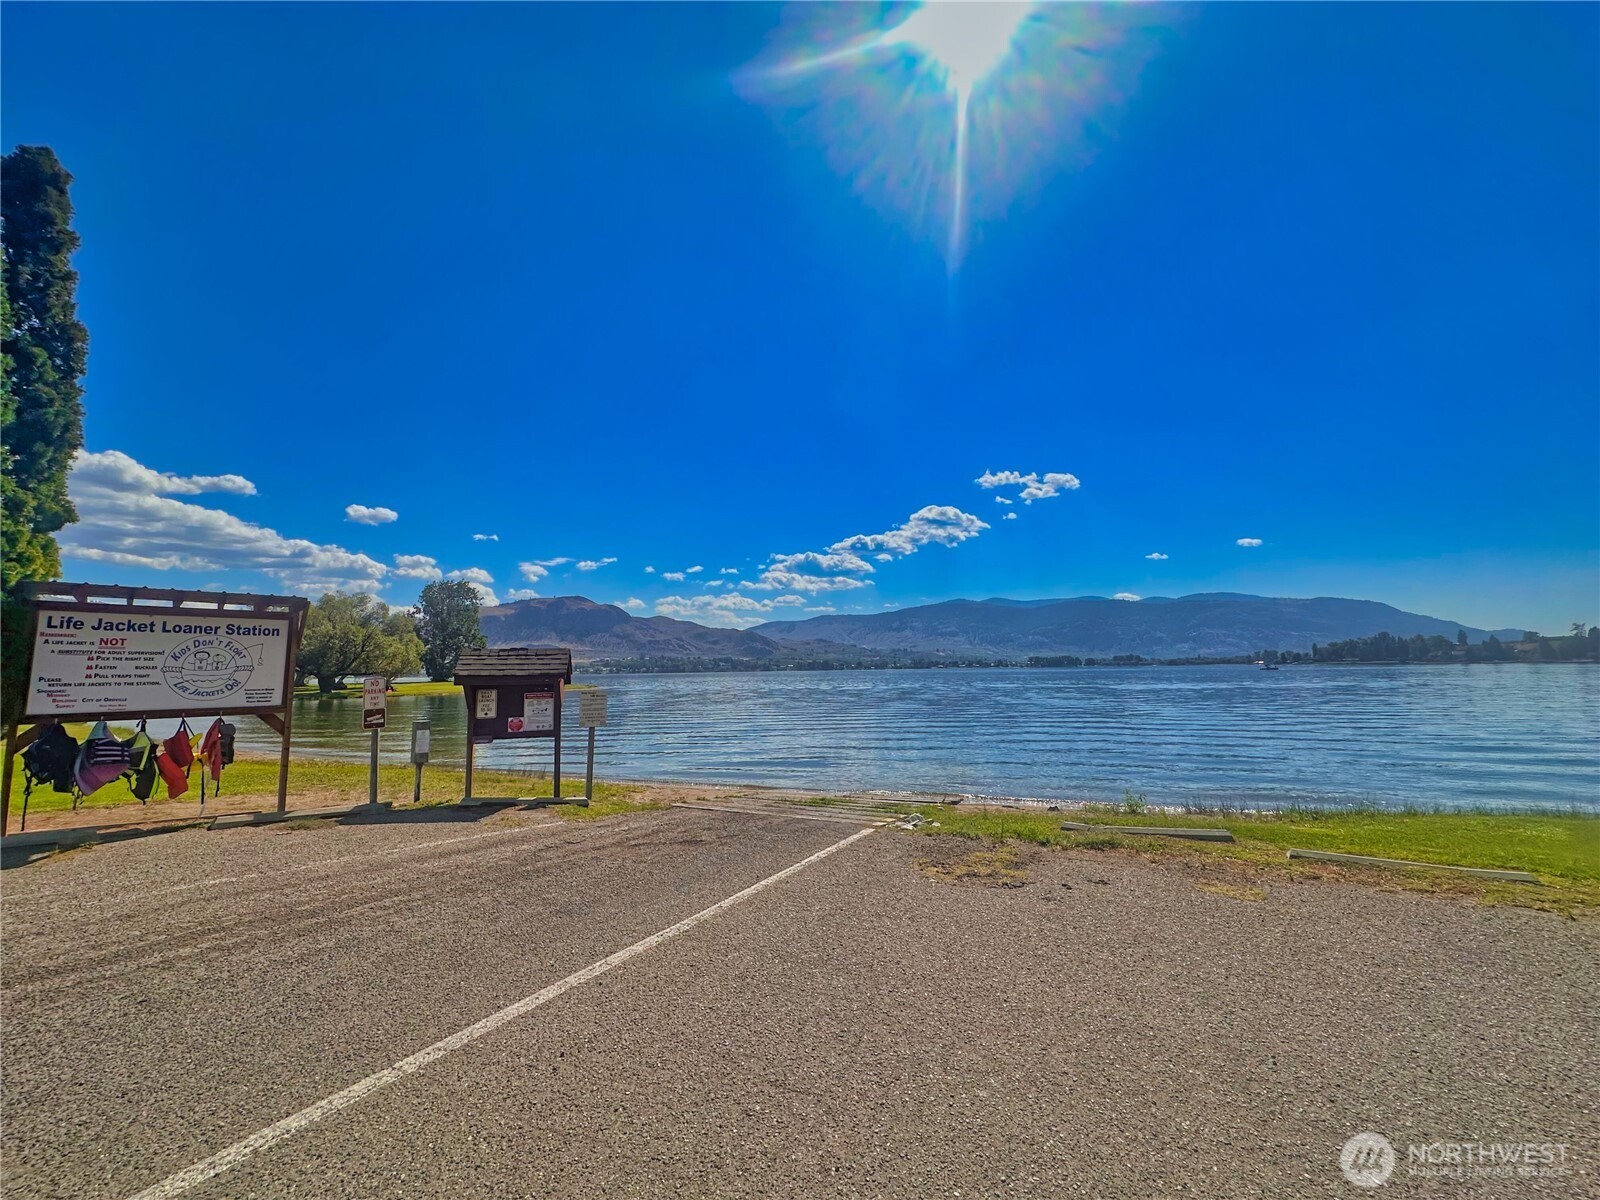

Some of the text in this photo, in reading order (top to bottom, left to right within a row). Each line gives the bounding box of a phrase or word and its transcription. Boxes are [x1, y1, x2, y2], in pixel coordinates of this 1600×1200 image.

[46, 615, 280, 636] Life Jacket Loaner Station
[98, 637, 127, 647] NOT
[170, 645, 191, 662] KIDS
[188, 688, 225, 697] JACKETS
